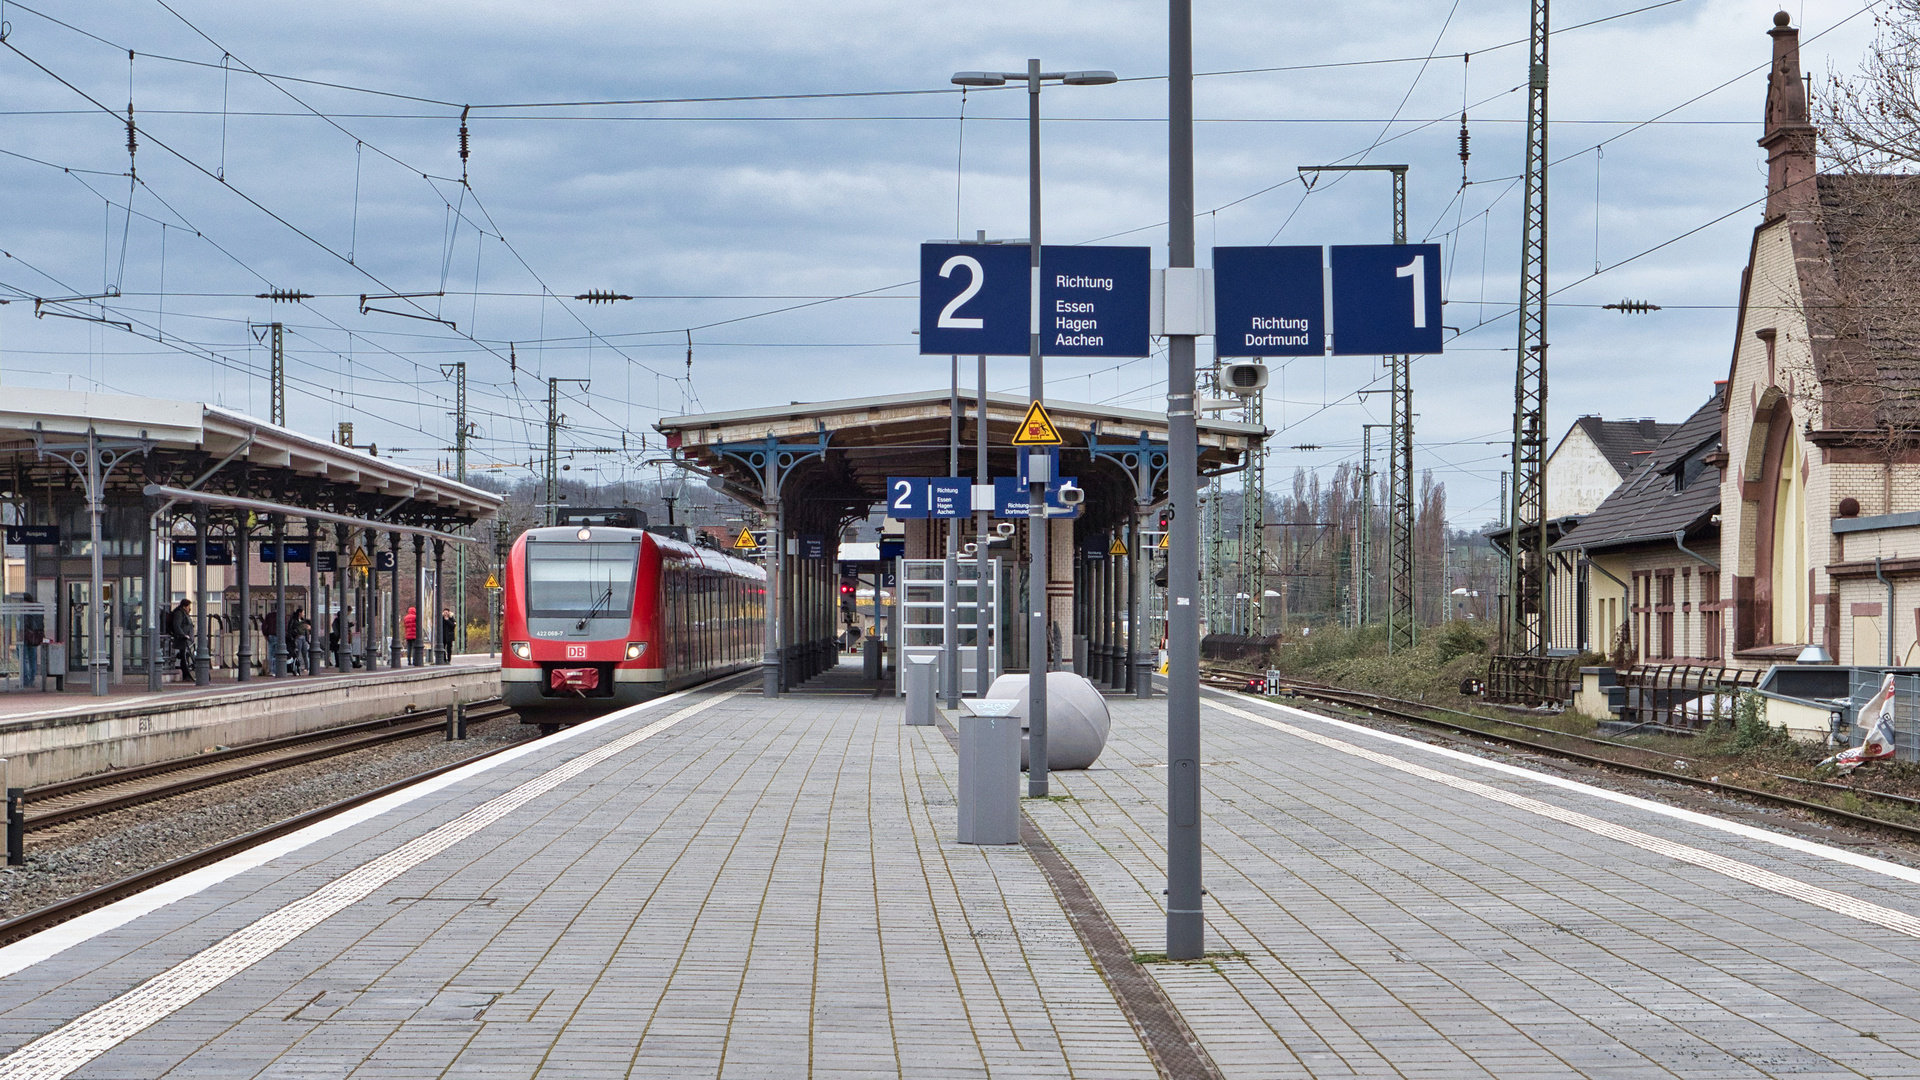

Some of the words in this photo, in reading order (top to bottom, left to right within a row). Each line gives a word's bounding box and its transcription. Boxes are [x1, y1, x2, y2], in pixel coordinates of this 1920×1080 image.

[1056, 274, 1113, 291] Richtung
[938, 255, 984, 329] 2
[1396, 255, 1426, 328] 1
[1056, 299, 1095, 313] Essen
[1056, 316, 1097, 332] Hagen
[1252, 316, 1309, 332] Richtung
[1055, 333, 1104, 347] Aachen
[1245, 333, 1309, 346] Dortmund
[894, 480, 912, 509] 2
[1008, 502, 1029, 510] Richtung
[384, 552, 395, 567] 3
[888, 574, 895, 585] 2
[568, 647, 585, 657] DB
[1268, 679, 1278, 694] H
